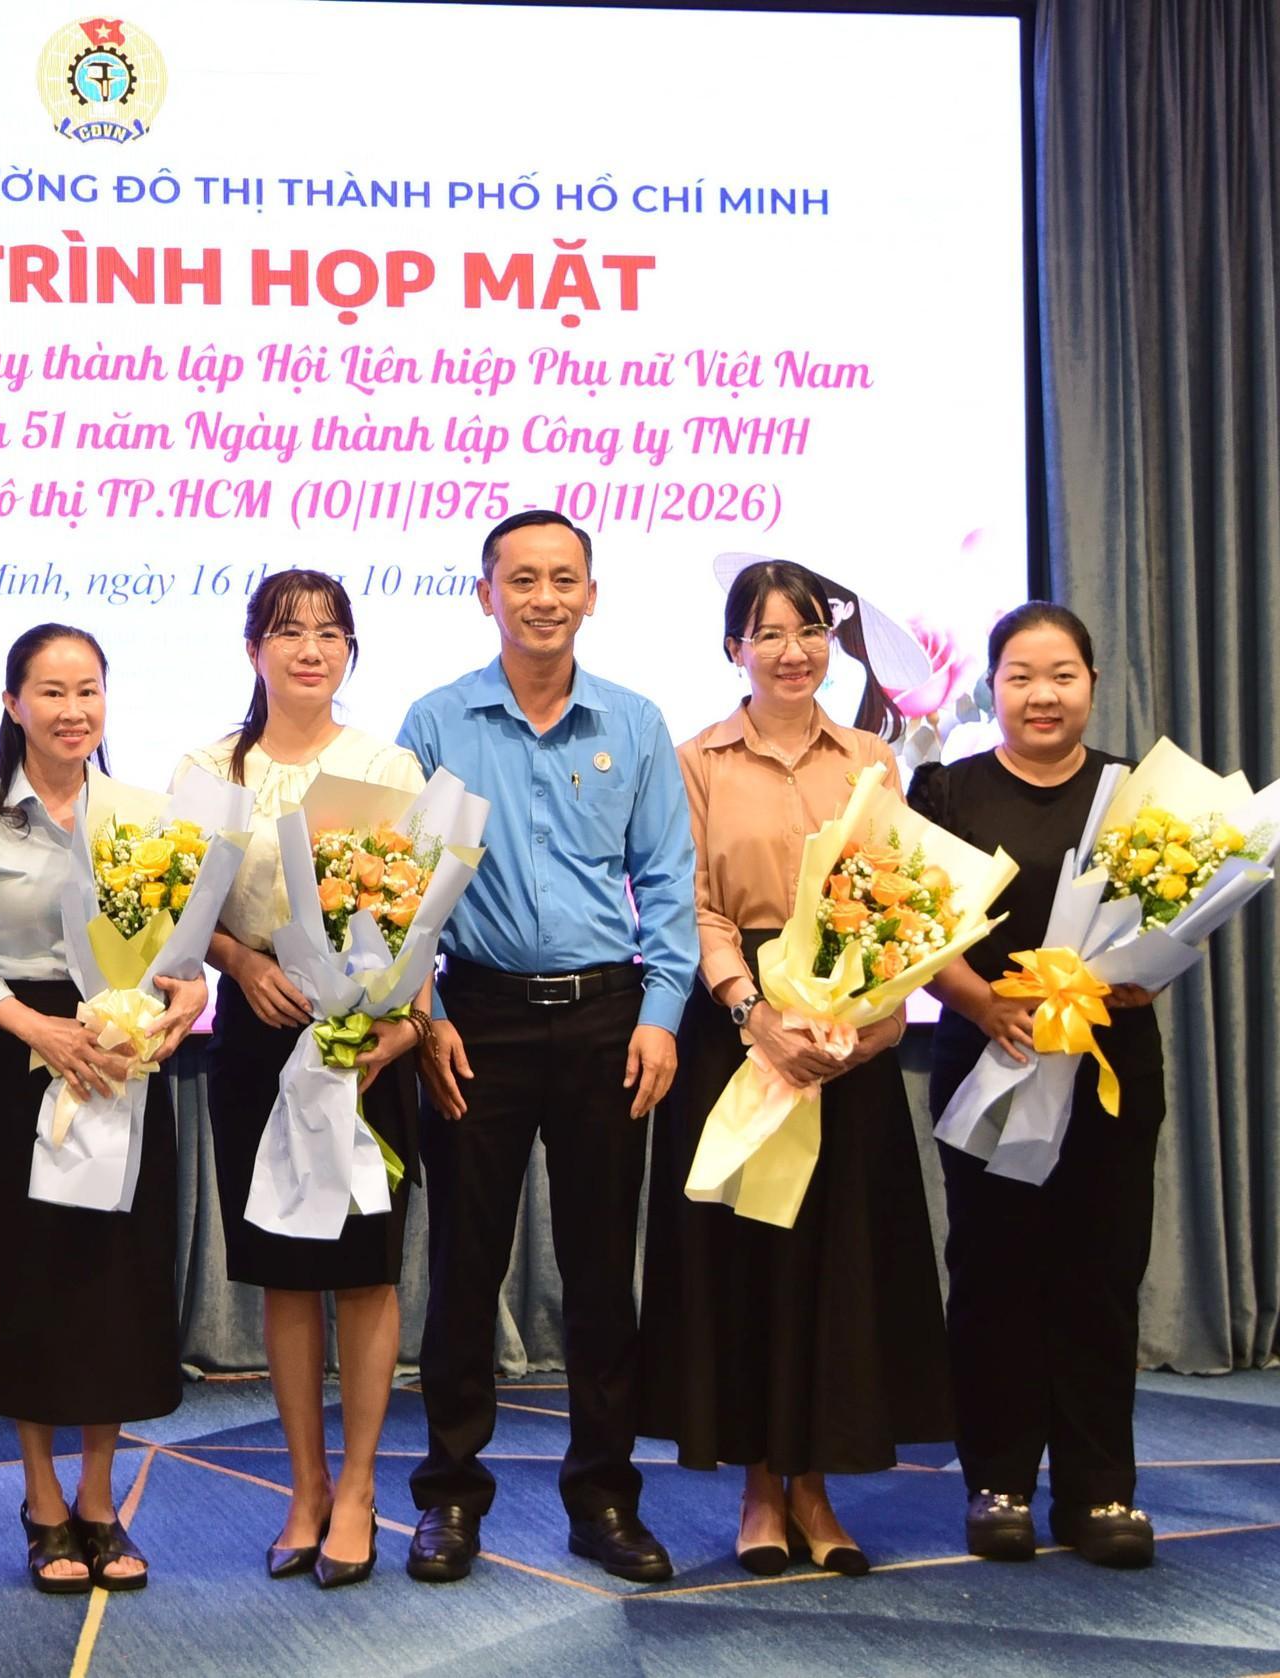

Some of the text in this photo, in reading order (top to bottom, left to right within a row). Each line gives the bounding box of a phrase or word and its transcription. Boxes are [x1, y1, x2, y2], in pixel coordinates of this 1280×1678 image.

[113, 168, 180, 204] ĐÔ
[194, 177, 264, 214] THỊ
[278, 173, 430, 208] THÀNH
[449, 173, 540, 211] PHỐ
[556, 177, 618, 212] HỒ
[632, 178, 704, 213] CHÍ
[720, 187, 828, 215] MINH
[251, 249, 436, 326] HỌP
[464, 238, 656, 328] MẶT
[43, 342, 167, 381] thành
[178, 344, 246, 393] lập
[258, 343, 331, 394] Hội
[340, 345, 421, 396] Liên
[431, 348, 518, 396] hiệp
[528, 349, 610, 398] Phụ
[620, 352, 677, 387] nữ
[684, 349, 764, 398] Việt
[775, 350, 873, 389] Nam
[22, 411, 67, 449] 51
[77, 413, 174, 449] năm
[185, 411, 300, 464] Ngày
[311, 413, 435, 452] thành
[444, 416, 511, 464] lập
[523, 416, 622, 466] Công
[633, 421, 672, 467] ty
[683, 416, 812, 455] TNHH
[29, 480, 86, 528] thị
[98, 478, 274, 518] TP.HCM
[291, 480, 510, 531] (10/11/1975
[552, 482, 782, 533] 10/11/2026)
[86, 563, 176, 605] ngày
[190, 564, 233, 596] 16
[361, 565, 402, 596] 10
